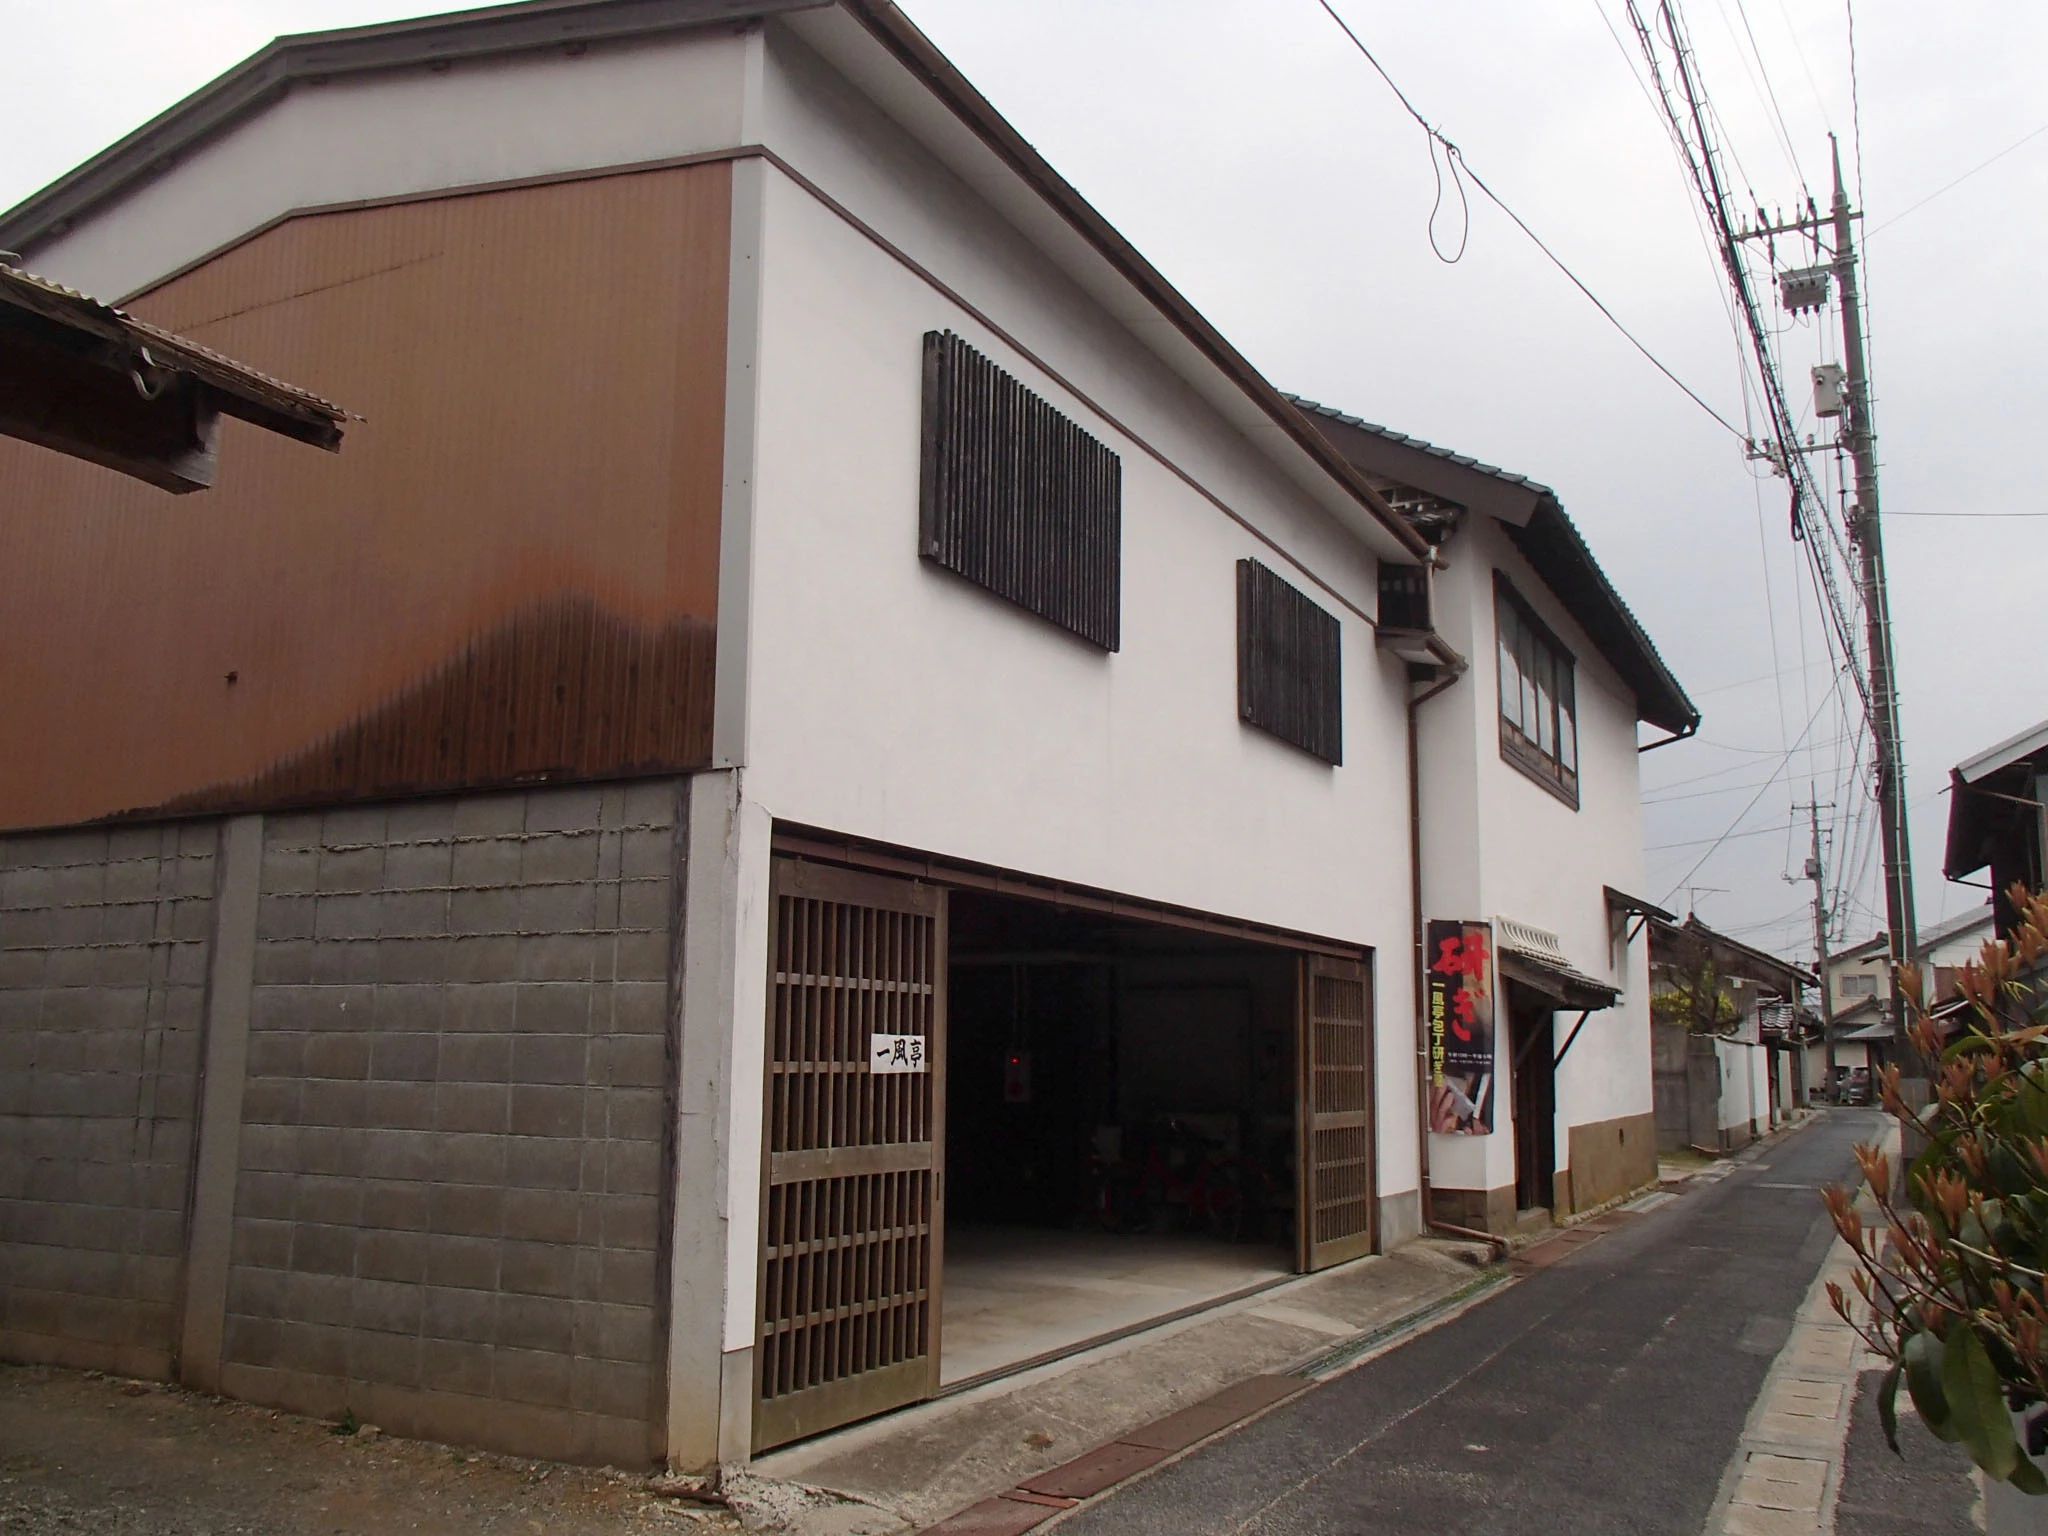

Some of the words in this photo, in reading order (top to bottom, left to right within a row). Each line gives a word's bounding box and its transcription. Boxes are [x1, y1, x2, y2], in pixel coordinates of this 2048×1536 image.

[1432, 930, 1489, 1041] 研ぎ
[876, 1038, 922, 1068] 一風亭
